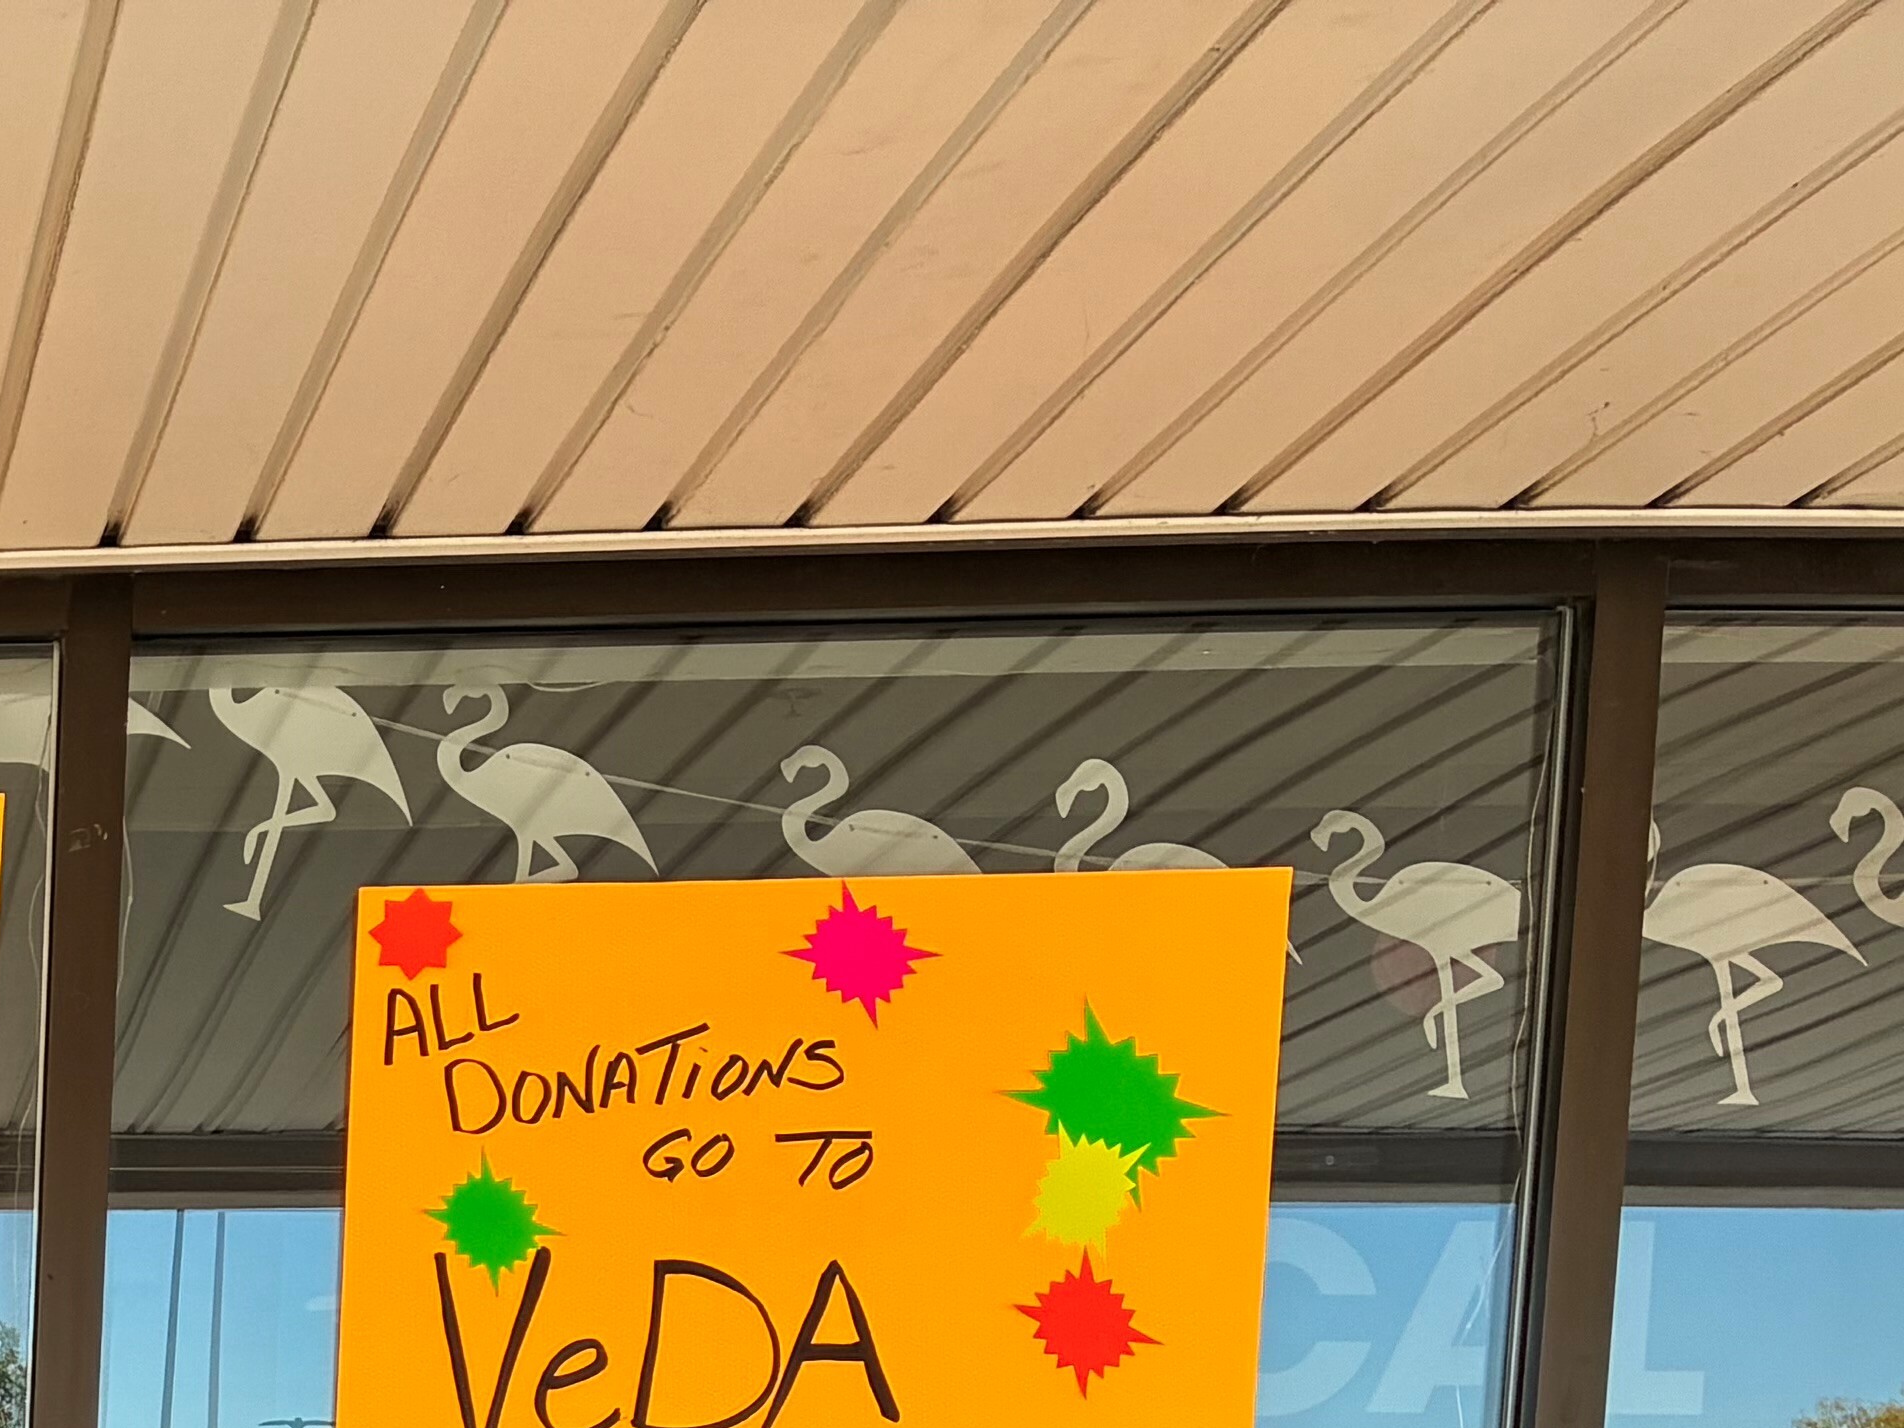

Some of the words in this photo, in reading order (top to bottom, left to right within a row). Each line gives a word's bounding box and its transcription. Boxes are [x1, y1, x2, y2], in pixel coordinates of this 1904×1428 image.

[383, 972, 518, 1066] ALL
[445, 1021, 844, 1136] DONATIONS
[642, 1128, 736, 1183] GO
[774, 1130, 875, 1190] TO
